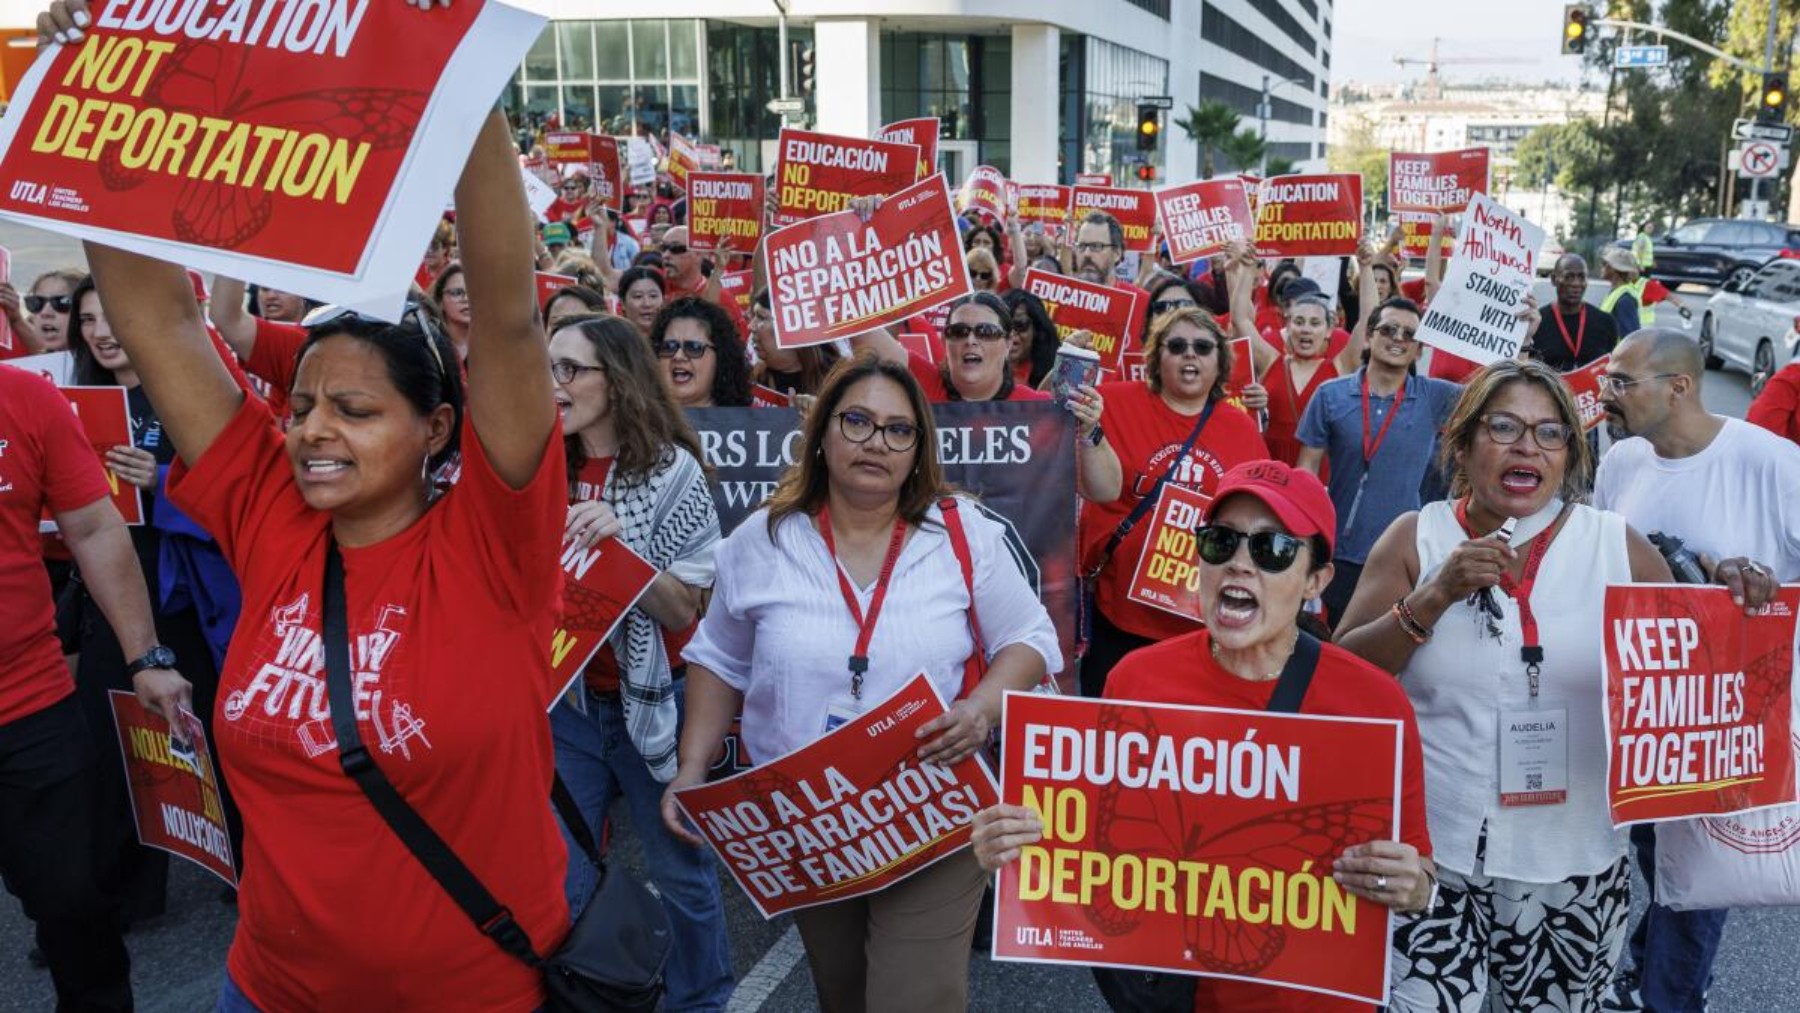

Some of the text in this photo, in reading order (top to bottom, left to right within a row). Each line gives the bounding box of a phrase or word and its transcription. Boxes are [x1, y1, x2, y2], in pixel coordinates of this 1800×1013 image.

[62, 35, 176, 97] NOT
[31, 94, 372, 205] DEPORTATION
[786, 139, 888, 173] EDUCACIÓN
[1395, 160, 1431, 176] KEEP
[9, 179, 47, 205] UTLA
[693, 180, 753, 200] EDUCATION
[783, 163, 810, 186] NO
[1259, 182, 1338, 204] DUCATION
[1395, 174, 1458, 191] FAMILIES
[693, 199, 717, 217] NOT
[1076, 191, 1139, 211] EDUCATION
[1164, 193, 1202, 216] KEEP
[1395, 188, 1471, 207] TOGETHER!
[1169, 206, 1232, 236] FAMILIES
[1254, 221, 1357, 241] DEPORTATION
[1474, 202, 1527, 249] North
[773, 226, 883, 276] ¡NO A LA
[777, 230, 944, 305] SEPARACIÓN
[1462, 226, 1533, 276] Hollywood
[782, 256, 956, 333] DE FAMILIAS!
[1031, 278, 1111, 315] EDUCATION
[1466, 272, 1520, 307] STANDS
[1424, 310, 1518, 359] IMMIGRANTS
[1480, 304, 1519, 334] WITH
[936, 424, 1031, 466] ELES
[1613, 617, 1699, 672] KEEP
[1621, 670, 1746, 730] FAMILIES
[867, 715, 896, 738] UTLA
[1510, 722, 1556, 733] AUDELIA
[1023, 723, 1301, 802] EDUCACIÓN
[1618, 723, 1765, 788] TOGETHER!
[699, 765, 859, 842] ¡NO A LA
[725, 760, 959, 872] SEPARACIÓN
[1021, 784, 1088, 844] NO
[161, 802, 232, 868] EDUCATION
[746, 784, 981, 899] DE FAMILIAS!
[1725, 815, 1793, 838] LOS ANGELES
[1018, 846, 1358, 936] DEPORTACIÓN
[1016, 926, 1053, 947] UTLA
